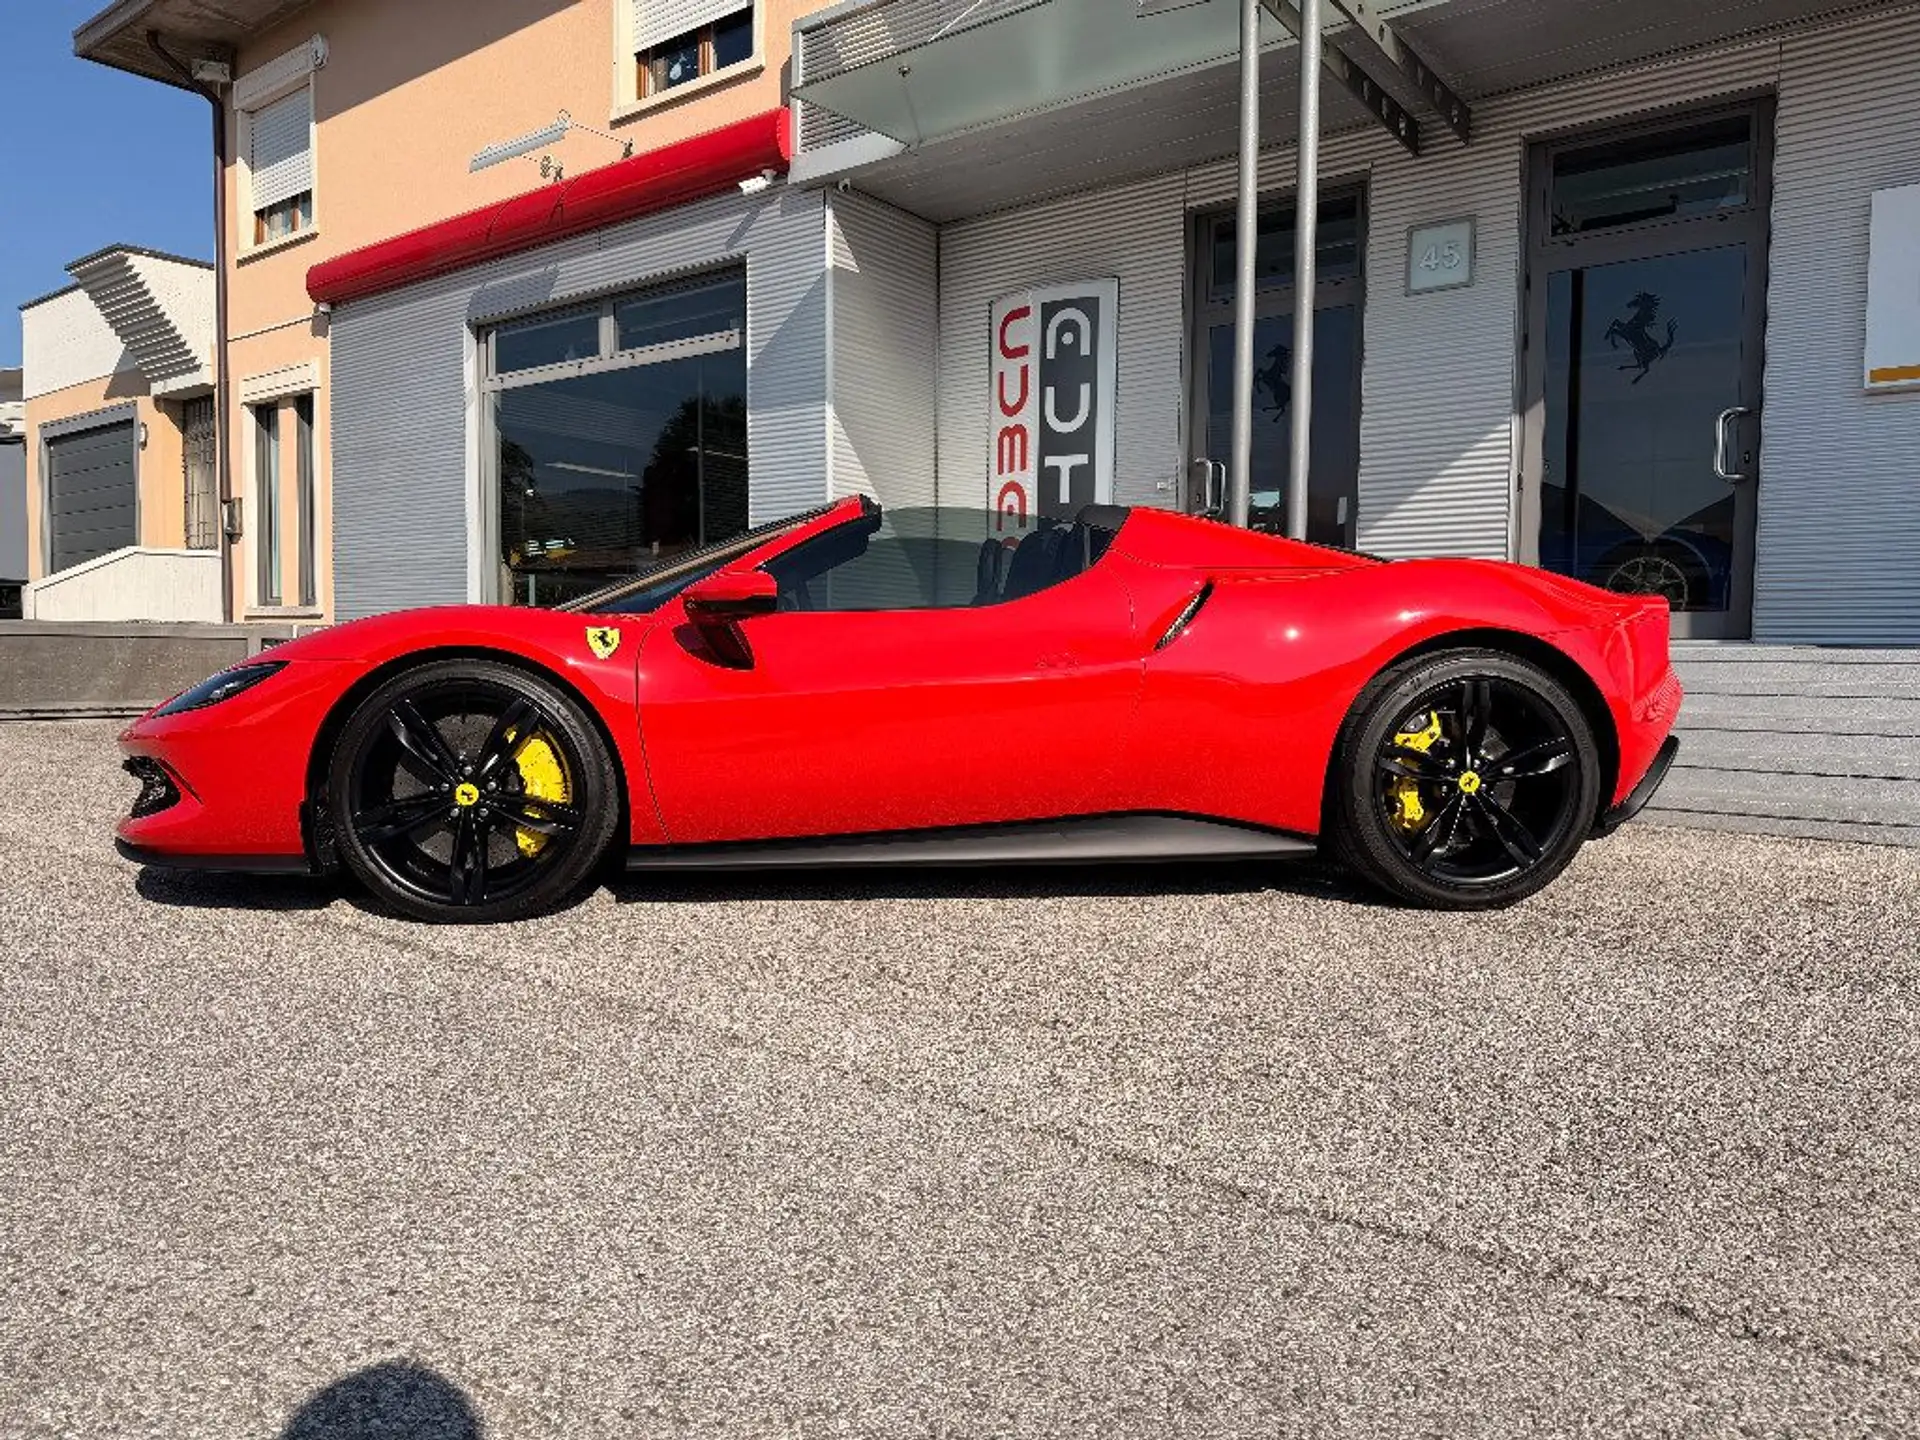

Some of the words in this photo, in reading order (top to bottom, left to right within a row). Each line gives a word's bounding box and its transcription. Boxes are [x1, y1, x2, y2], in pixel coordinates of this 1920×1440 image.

[1420, 242, 1460, 270] 45
[997, 305, 1031, 548] CUMA
[1044, 307, 1091, 533] AUT
